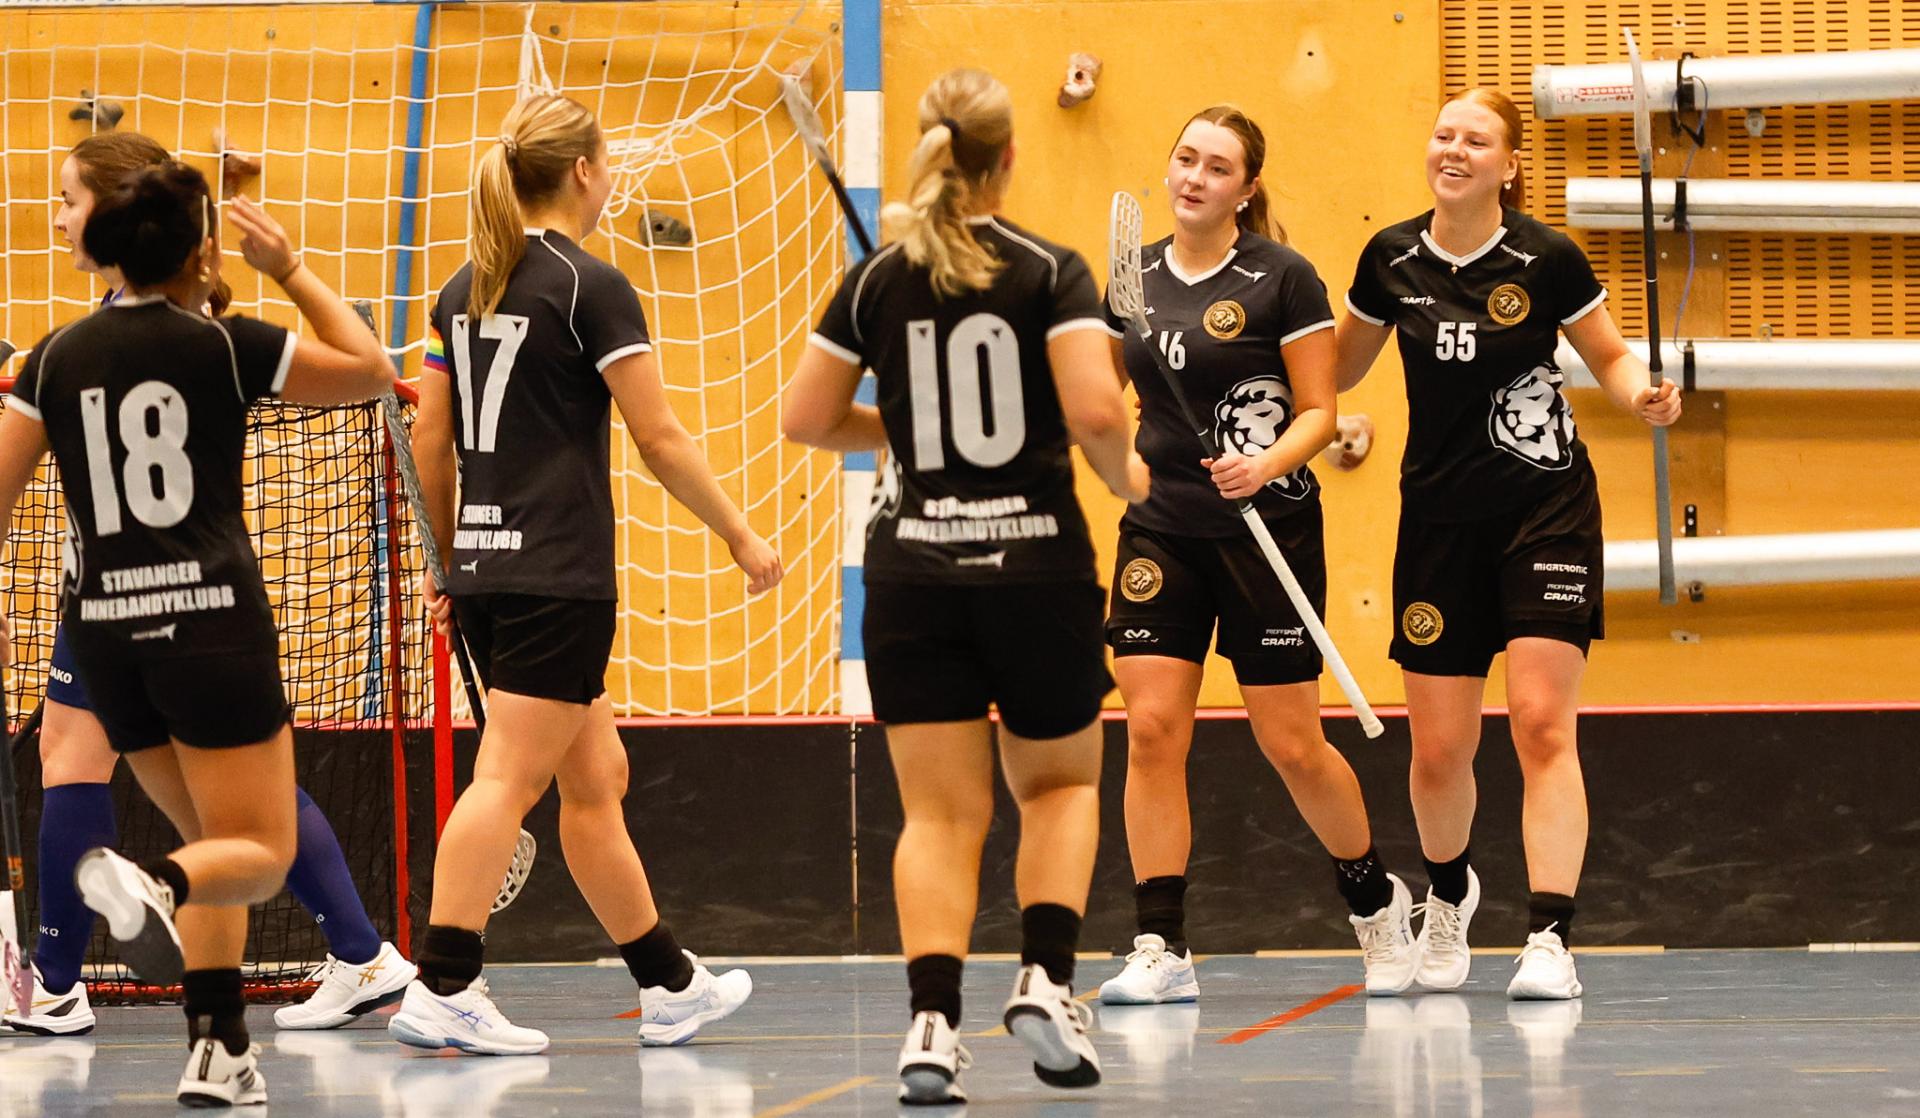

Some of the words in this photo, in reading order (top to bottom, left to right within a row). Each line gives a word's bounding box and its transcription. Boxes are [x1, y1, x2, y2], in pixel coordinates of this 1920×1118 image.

[1159, 330, 1186, 370] 16
[1435, 321, 1477, 362] 55
[451, 313, 530, 453] 17
[907, 312, 1026, 472] 10
[80, 380, 195, 537] 18
[101, 560, 202, 594] STAVANGER
[80, 584, 235, 621] INNEBANDYKLUBB
[1543, 592, 1580, 603] CRAFT
[1261, 637, 1298, 647] CRAFT
